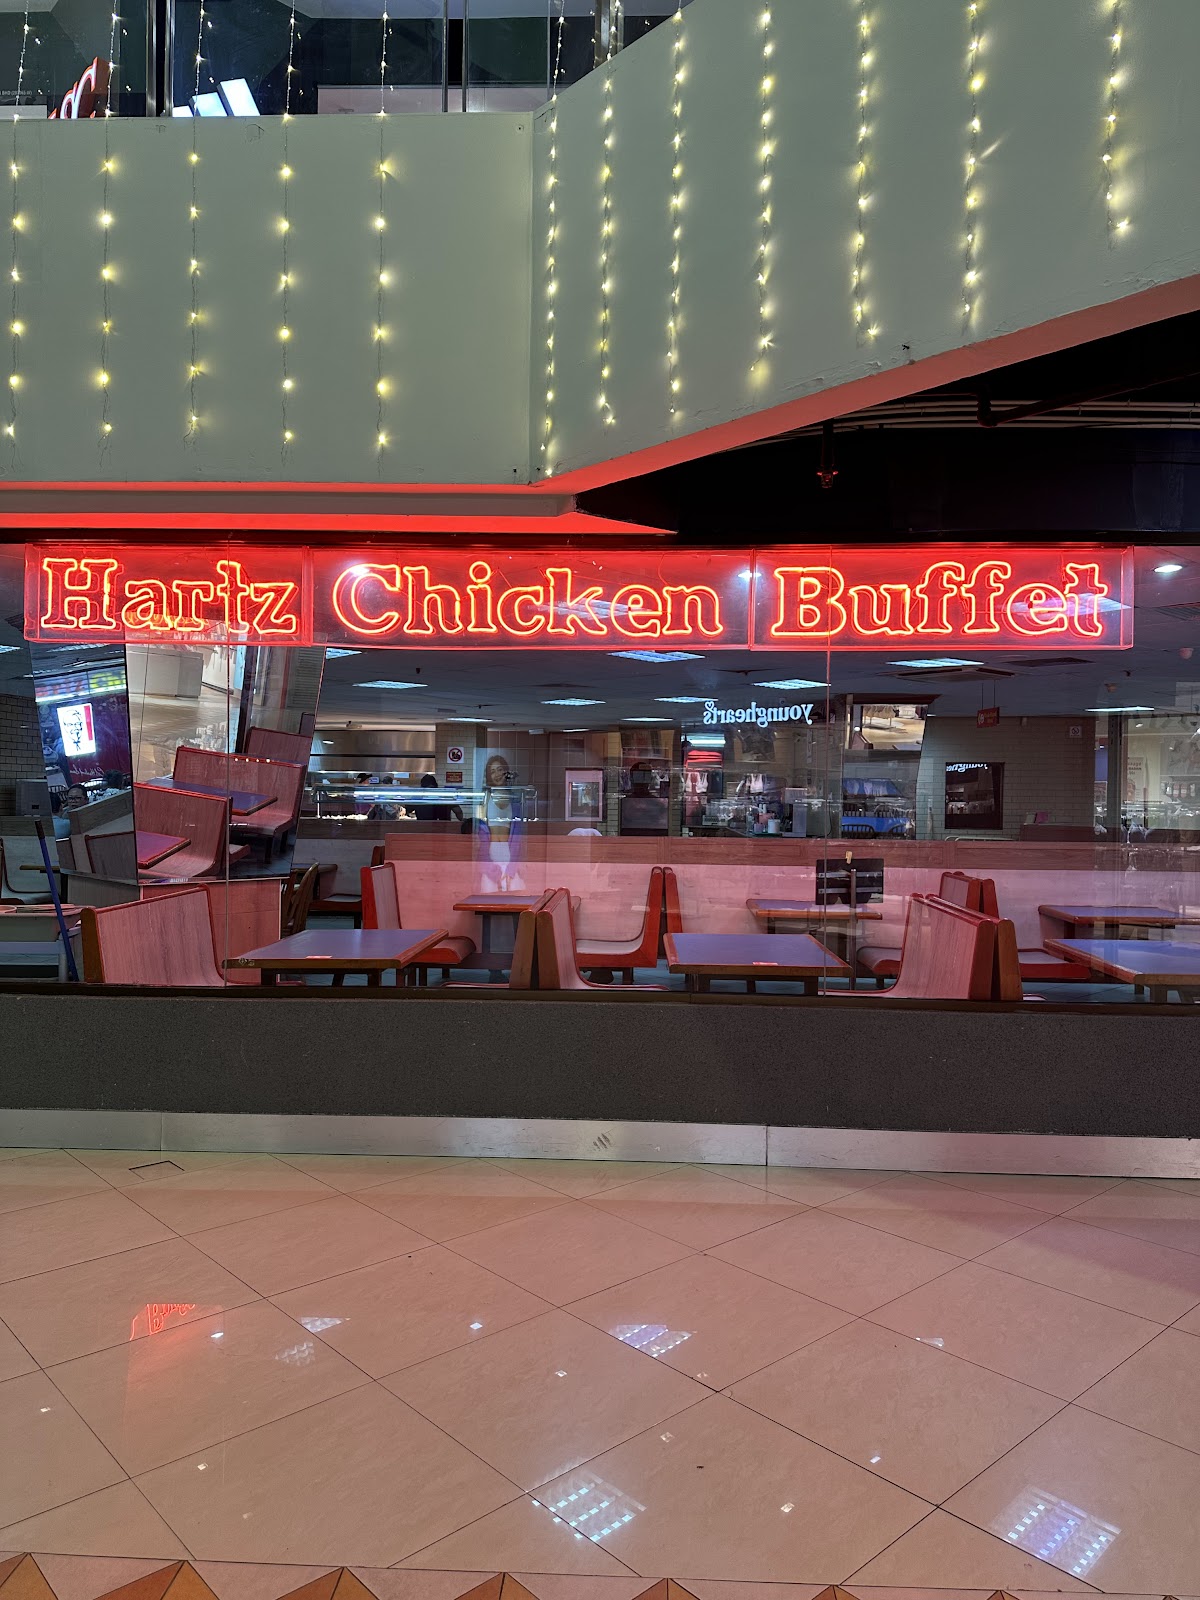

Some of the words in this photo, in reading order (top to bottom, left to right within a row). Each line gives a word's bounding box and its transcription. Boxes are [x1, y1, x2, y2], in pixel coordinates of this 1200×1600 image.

[41, 557, 299, 635] Hartz
[333, 561, 724, 638] Chicken
[771, 560, 1109, 637] Buffet
